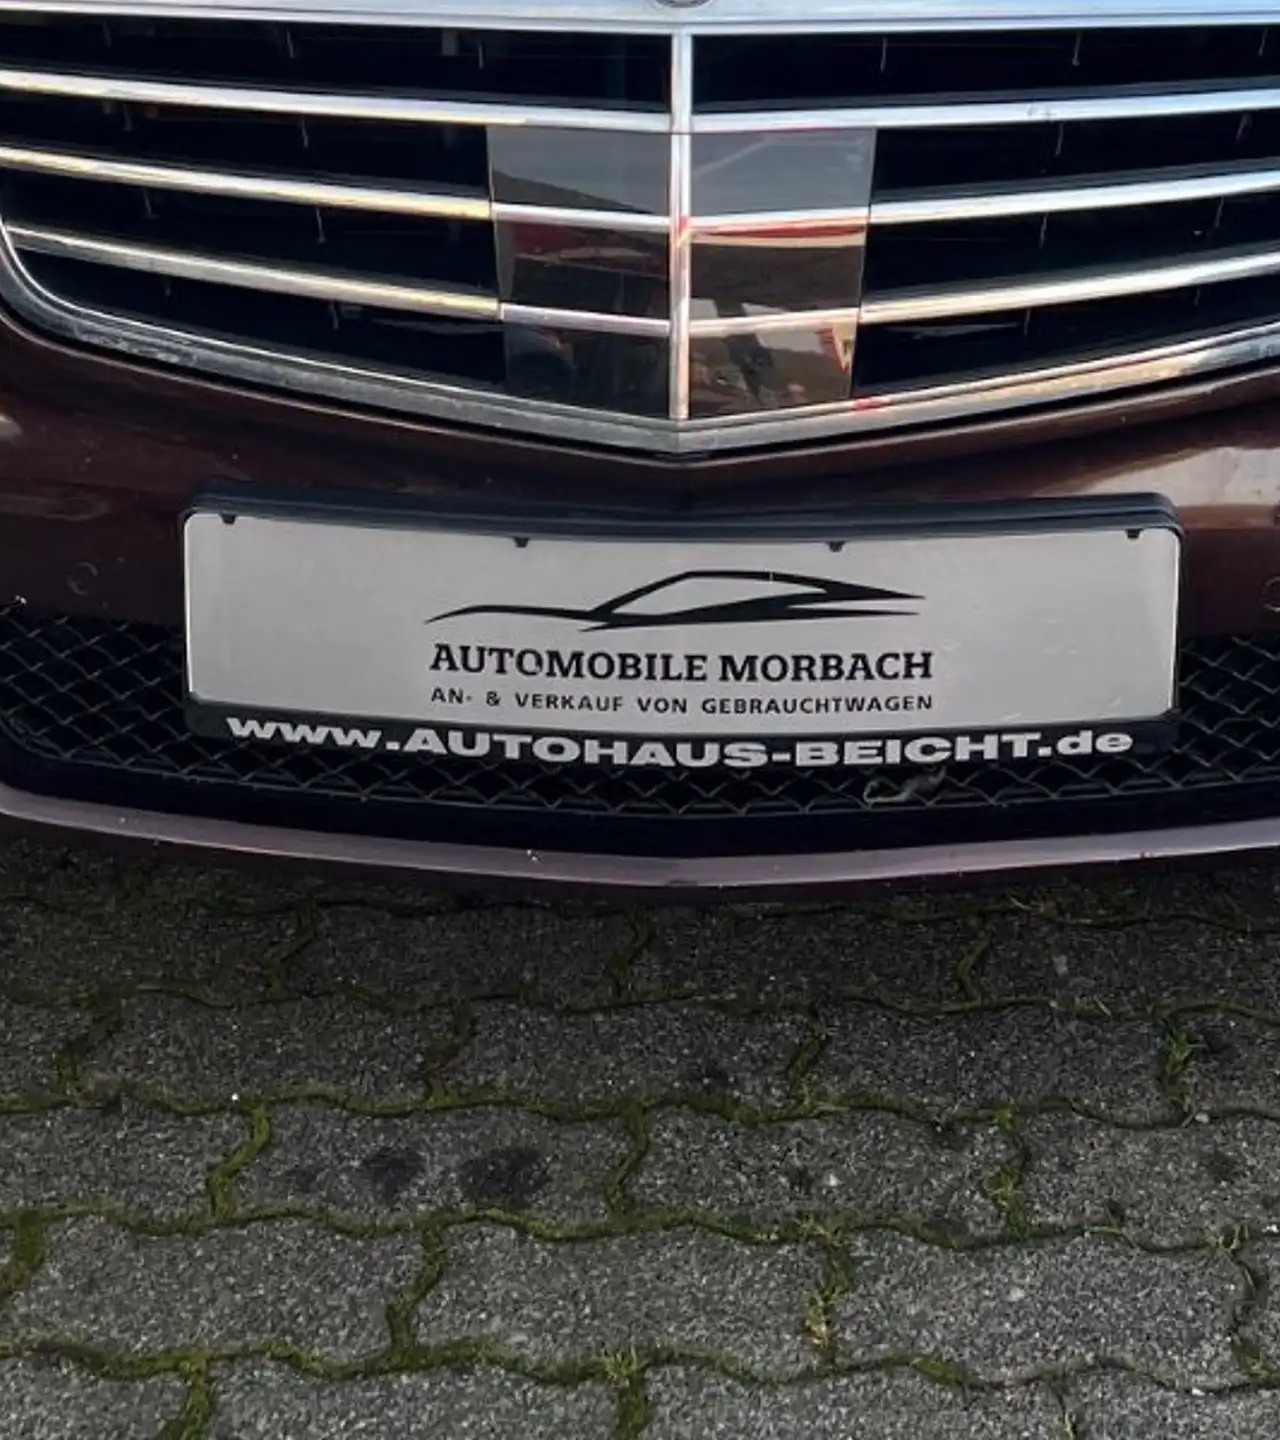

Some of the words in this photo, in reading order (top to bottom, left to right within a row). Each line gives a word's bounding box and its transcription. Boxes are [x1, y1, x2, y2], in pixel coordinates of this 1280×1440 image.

[429, 643, 709, 682] AUTOMOBILE
[717, 650, 934, 683] MORBACH
[429, 687, 473, 706] AN-
[484, 690, 502, 707] &
[513, 691, 626, 713] VERKAUF
[636, 695, 689, 715] VON
[701, 694, 934, 716] GEBRAUCHTWAGEN
[225, 715, 1134, 768] www.AUTOHAUS-BEICHT.de
